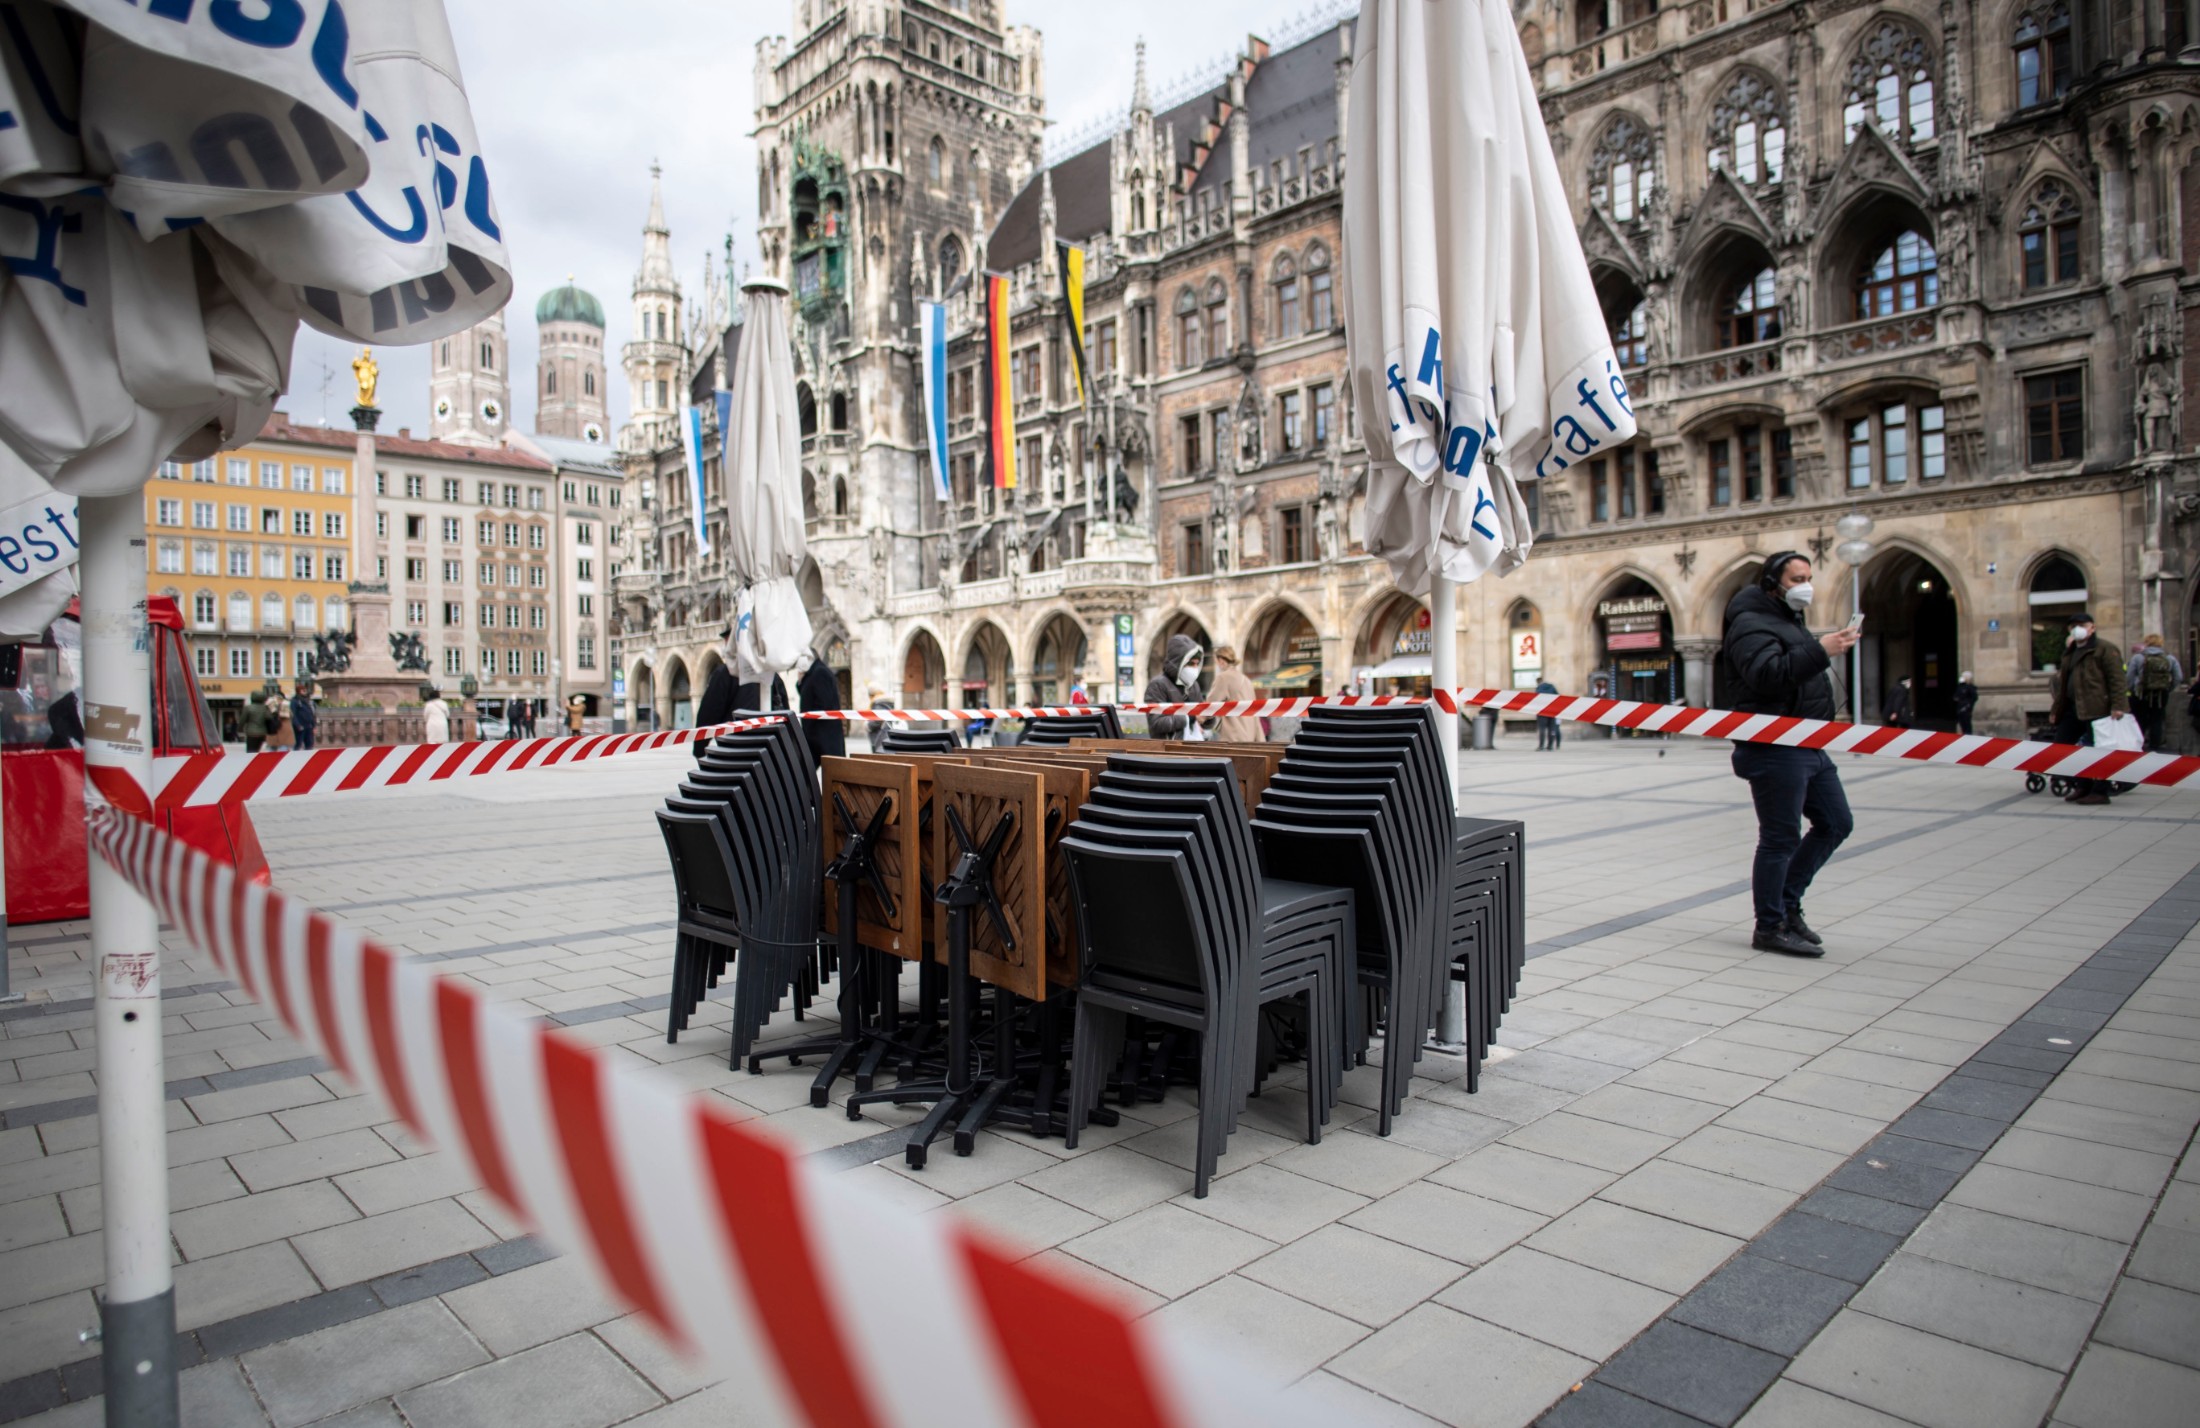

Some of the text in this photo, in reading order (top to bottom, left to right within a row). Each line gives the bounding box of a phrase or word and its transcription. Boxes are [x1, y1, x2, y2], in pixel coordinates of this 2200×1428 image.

[0, 506, 79, 583] est
[1600, 598, 1666, 615] Ratskeller
[1120, 616, 1131, 634] S
[1120, 636, 1131, 654] U
